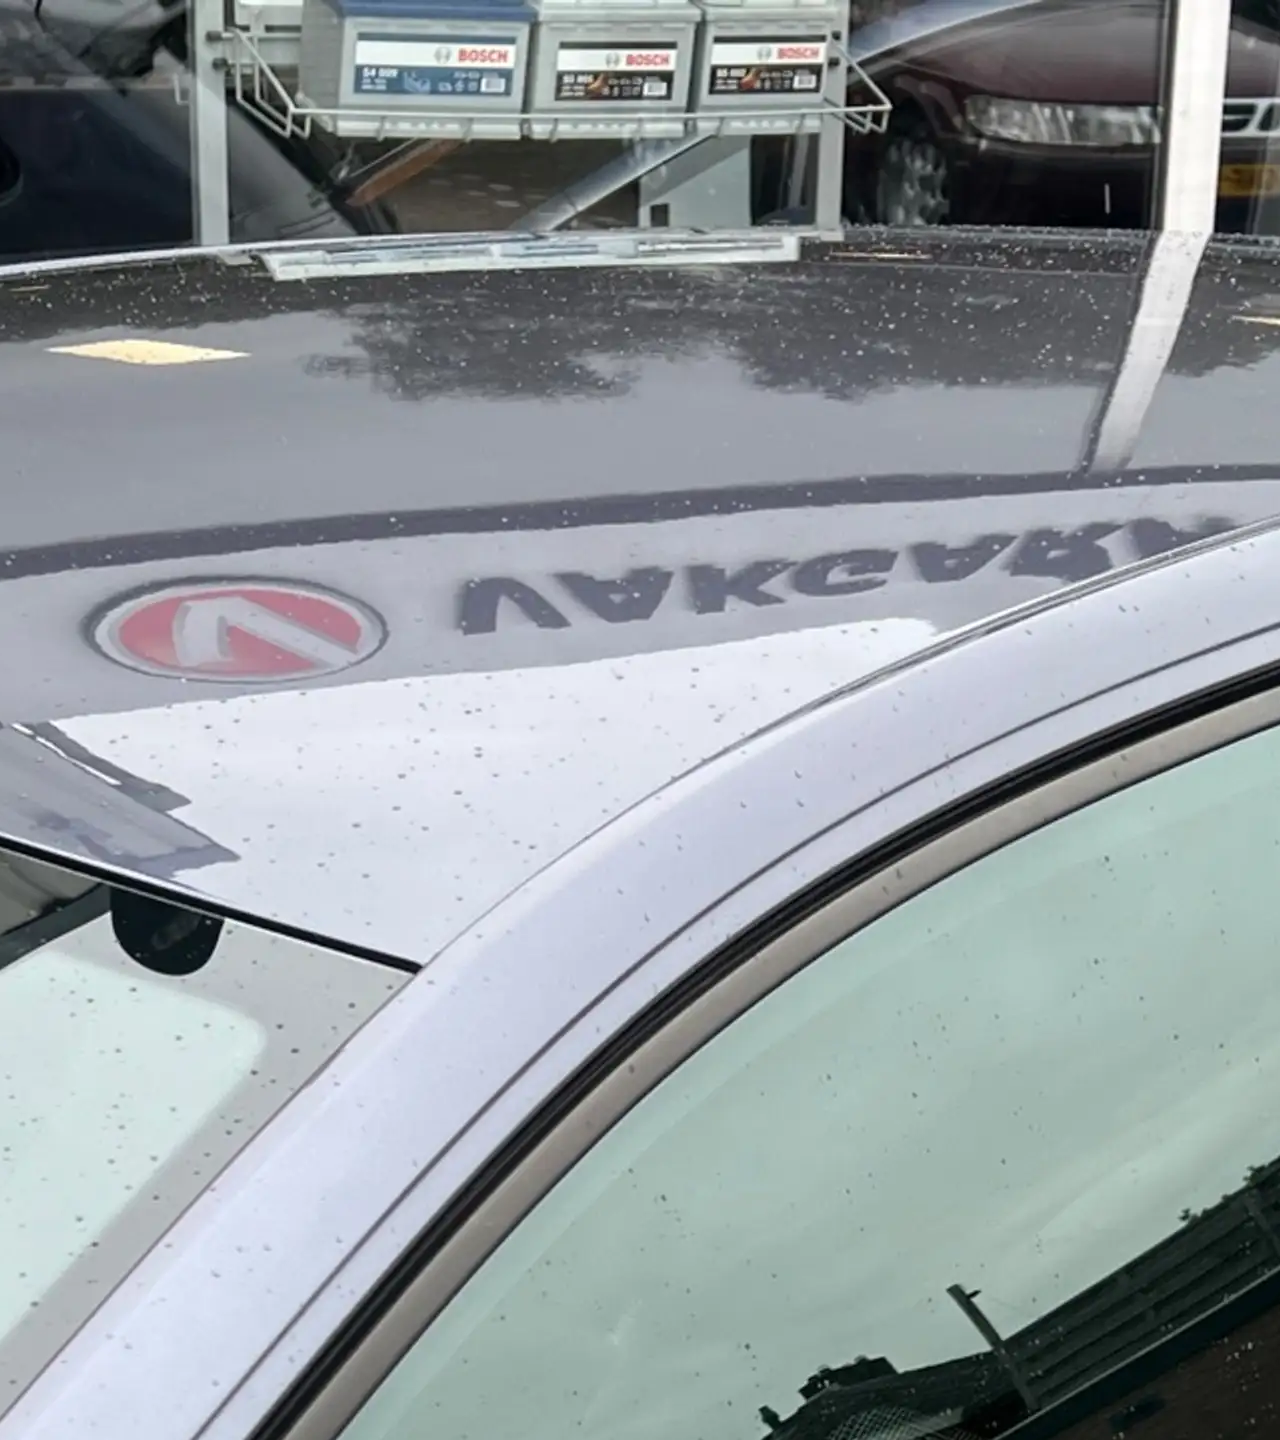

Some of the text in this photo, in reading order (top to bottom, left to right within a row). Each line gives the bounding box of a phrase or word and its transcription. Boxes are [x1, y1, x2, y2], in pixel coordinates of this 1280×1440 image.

[458, 49, 509, 63] BOSCH
[777, 47, 820, 60] BOSCH
[625, 54, 670, 67] BOSCH
